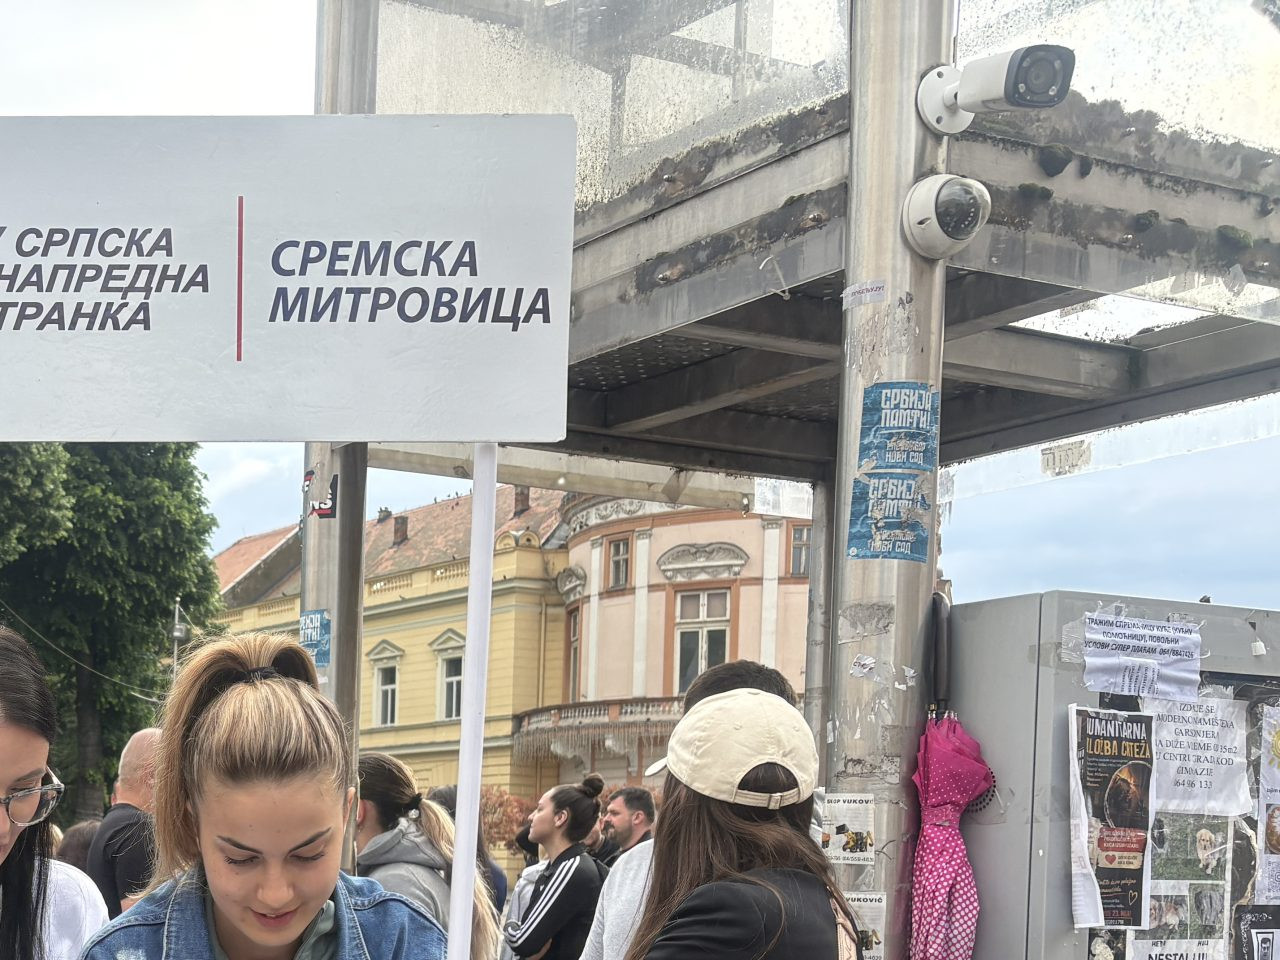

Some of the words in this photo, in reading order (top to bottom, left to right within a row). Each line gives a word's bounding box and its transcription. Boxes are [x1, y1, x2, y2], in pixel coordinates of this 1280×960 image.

[15, 228, 174, 258] СРПСКА
[271, 240, 478, 277] СРЕМСКА
[269, 287, 552, 332] МИТРОВИЦА
[881, 389, 932, 411] СРБИЈА
